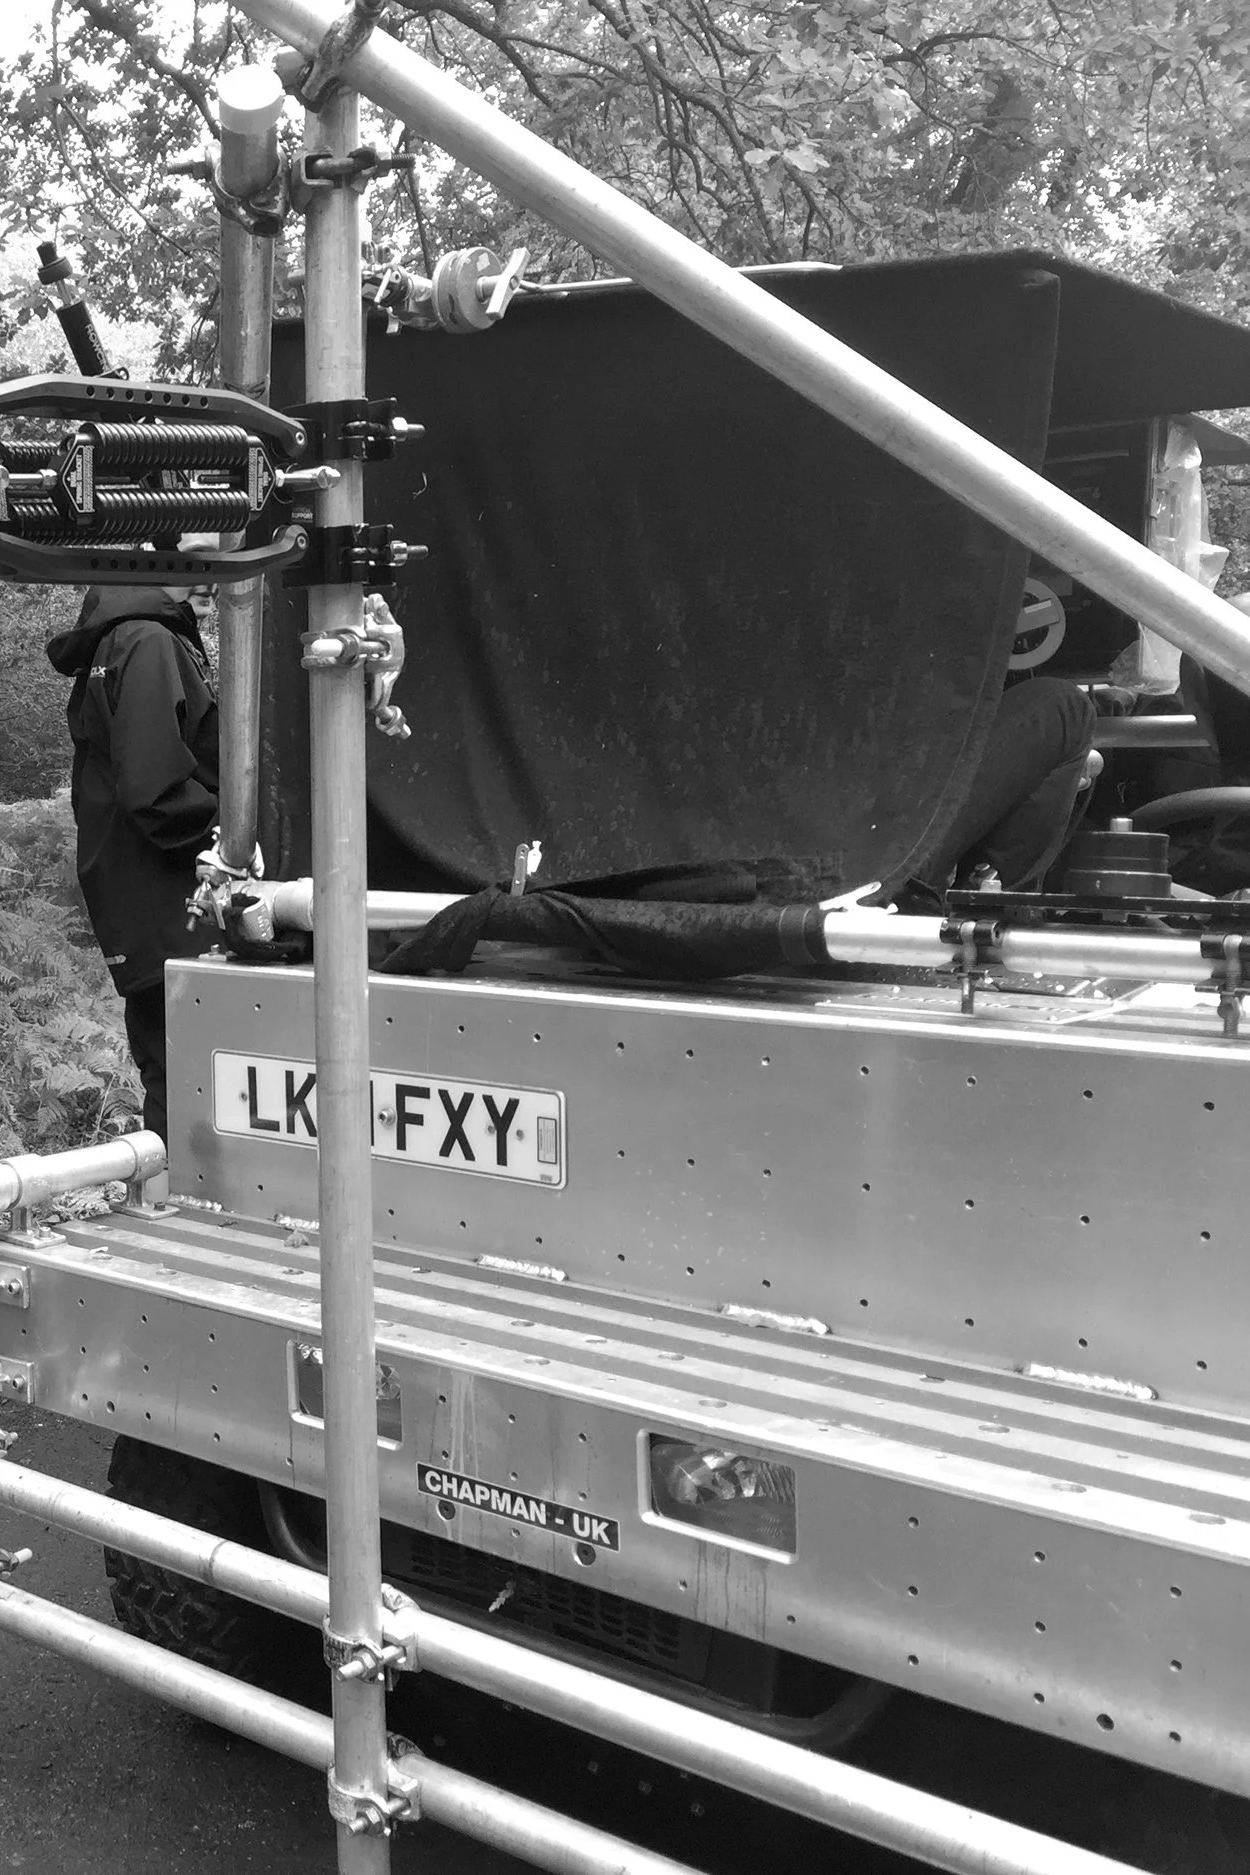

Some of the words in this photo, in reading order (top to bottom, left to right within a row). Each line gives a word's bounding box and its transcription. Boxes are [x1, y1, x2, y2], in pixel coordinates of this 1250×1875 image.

[395, 1083, 520, 1167] FXY
[425, 1471, 547, 1525] CHAPMAN
[573, 1513, 612, 1545] UK
